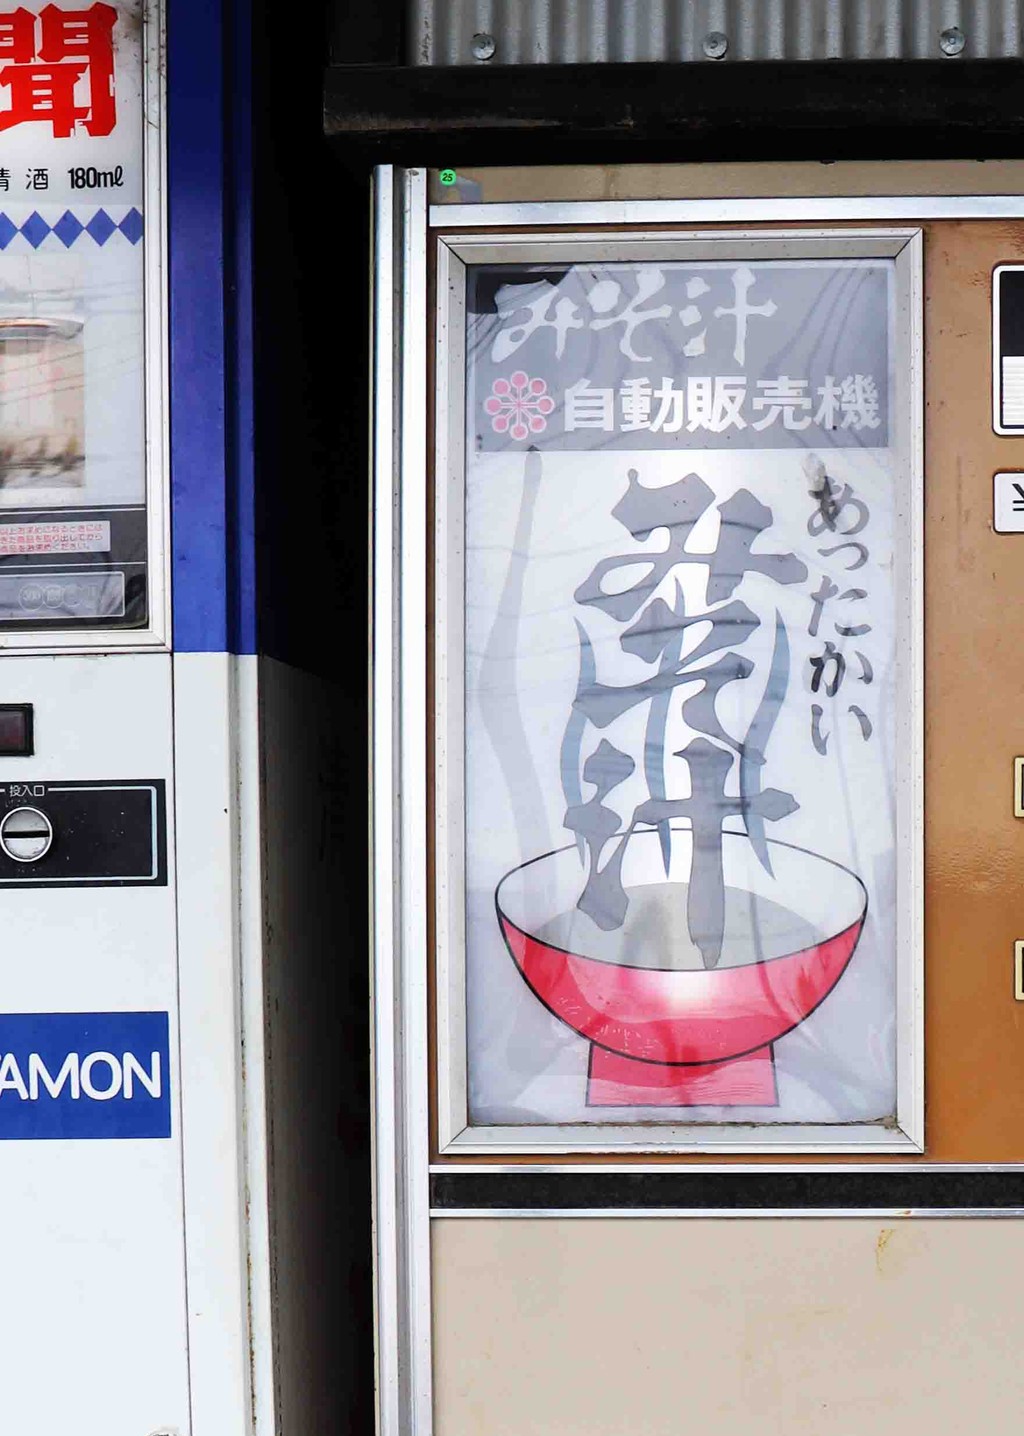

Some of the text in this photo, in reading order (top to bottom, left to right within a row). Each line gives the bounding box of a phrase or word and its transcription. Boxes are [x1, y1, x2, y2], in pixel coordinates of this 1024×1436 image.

[442, 172, 453, 182] 25
[491, 268, 778, 366] みそ汁
[563, 374, 882, 432] 自動販売機
[806, 472, 873, 756] あったかい
[9, 784, 45, 797] 投入口
[0, 1051, 162, 1100] AMON
